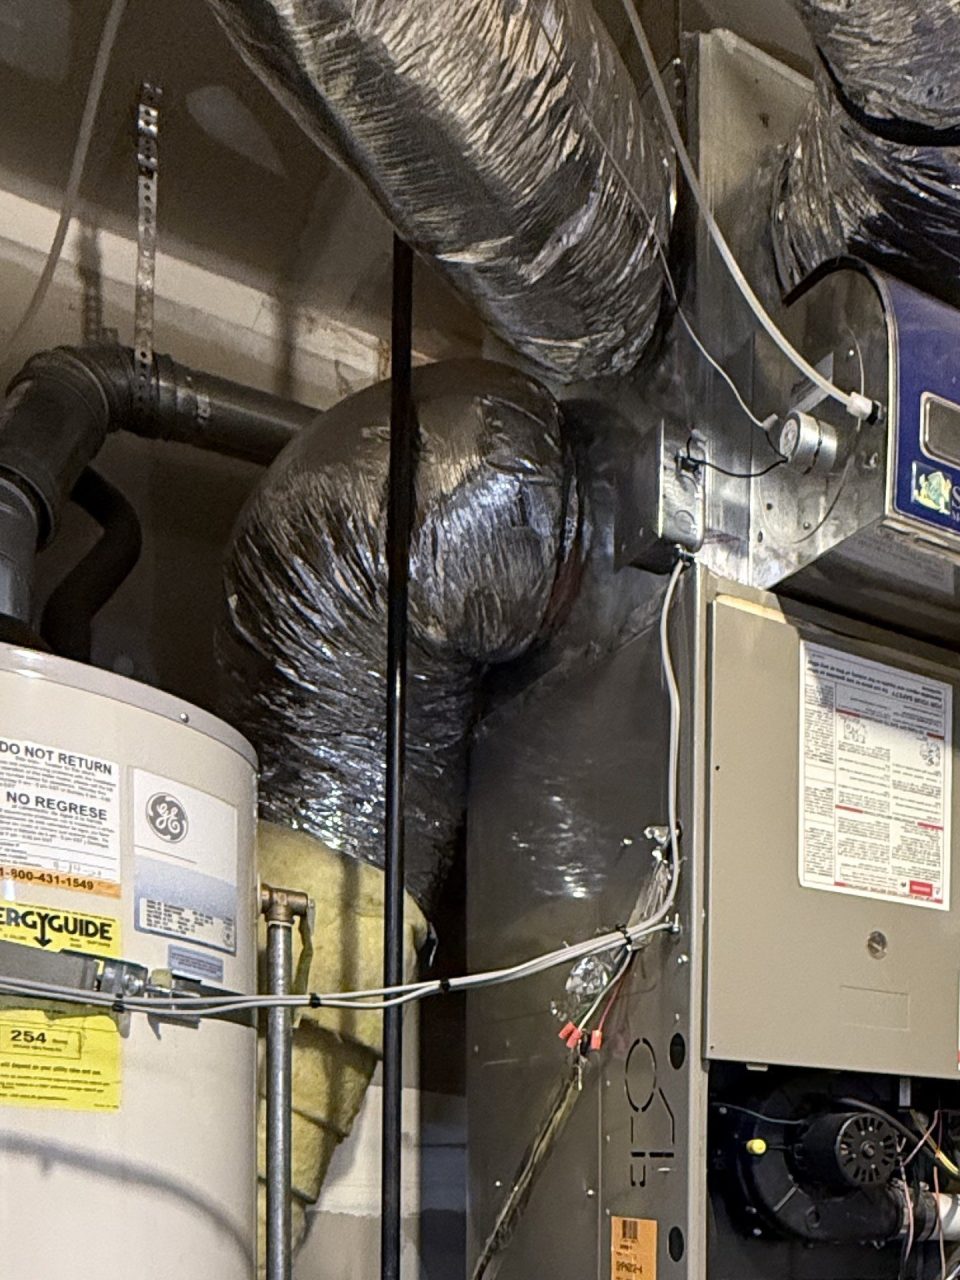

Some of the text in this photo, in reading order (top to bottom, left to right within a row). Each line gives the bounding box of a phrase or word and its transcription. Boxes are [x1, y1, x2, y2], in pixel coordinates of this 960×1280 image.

[0, 740, 112, 775] DO NOT RETURN
[6, 791, 107, 821] NO REGRESE
[10, 1030, 46, 1043] 254
